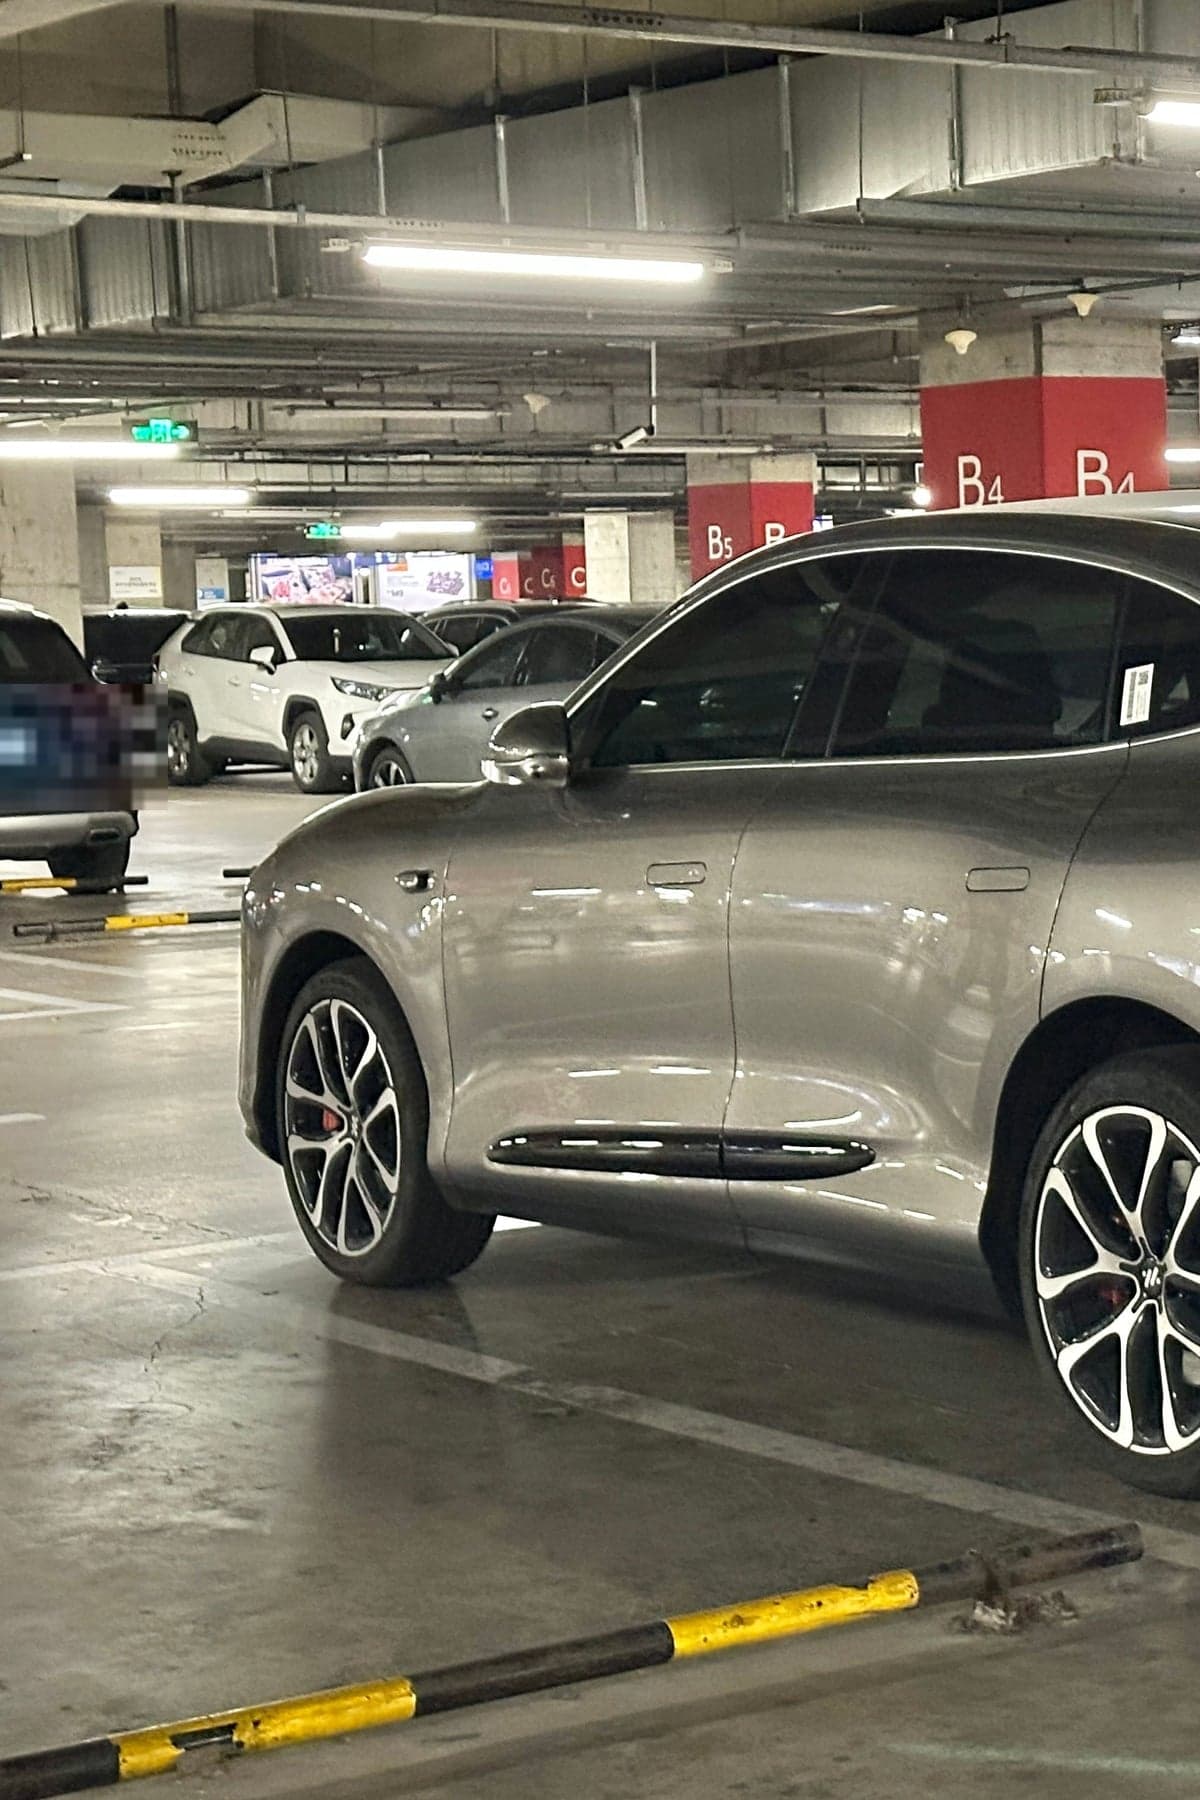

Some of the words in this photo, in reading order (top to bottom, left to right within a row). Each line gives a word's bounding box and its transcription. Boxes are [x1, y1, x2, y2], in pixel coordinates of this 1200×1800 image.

[957, 454, 1004, 508] B4
[1077, 449, 1135, 497] B4
[707, 525, 733, 560] B5
